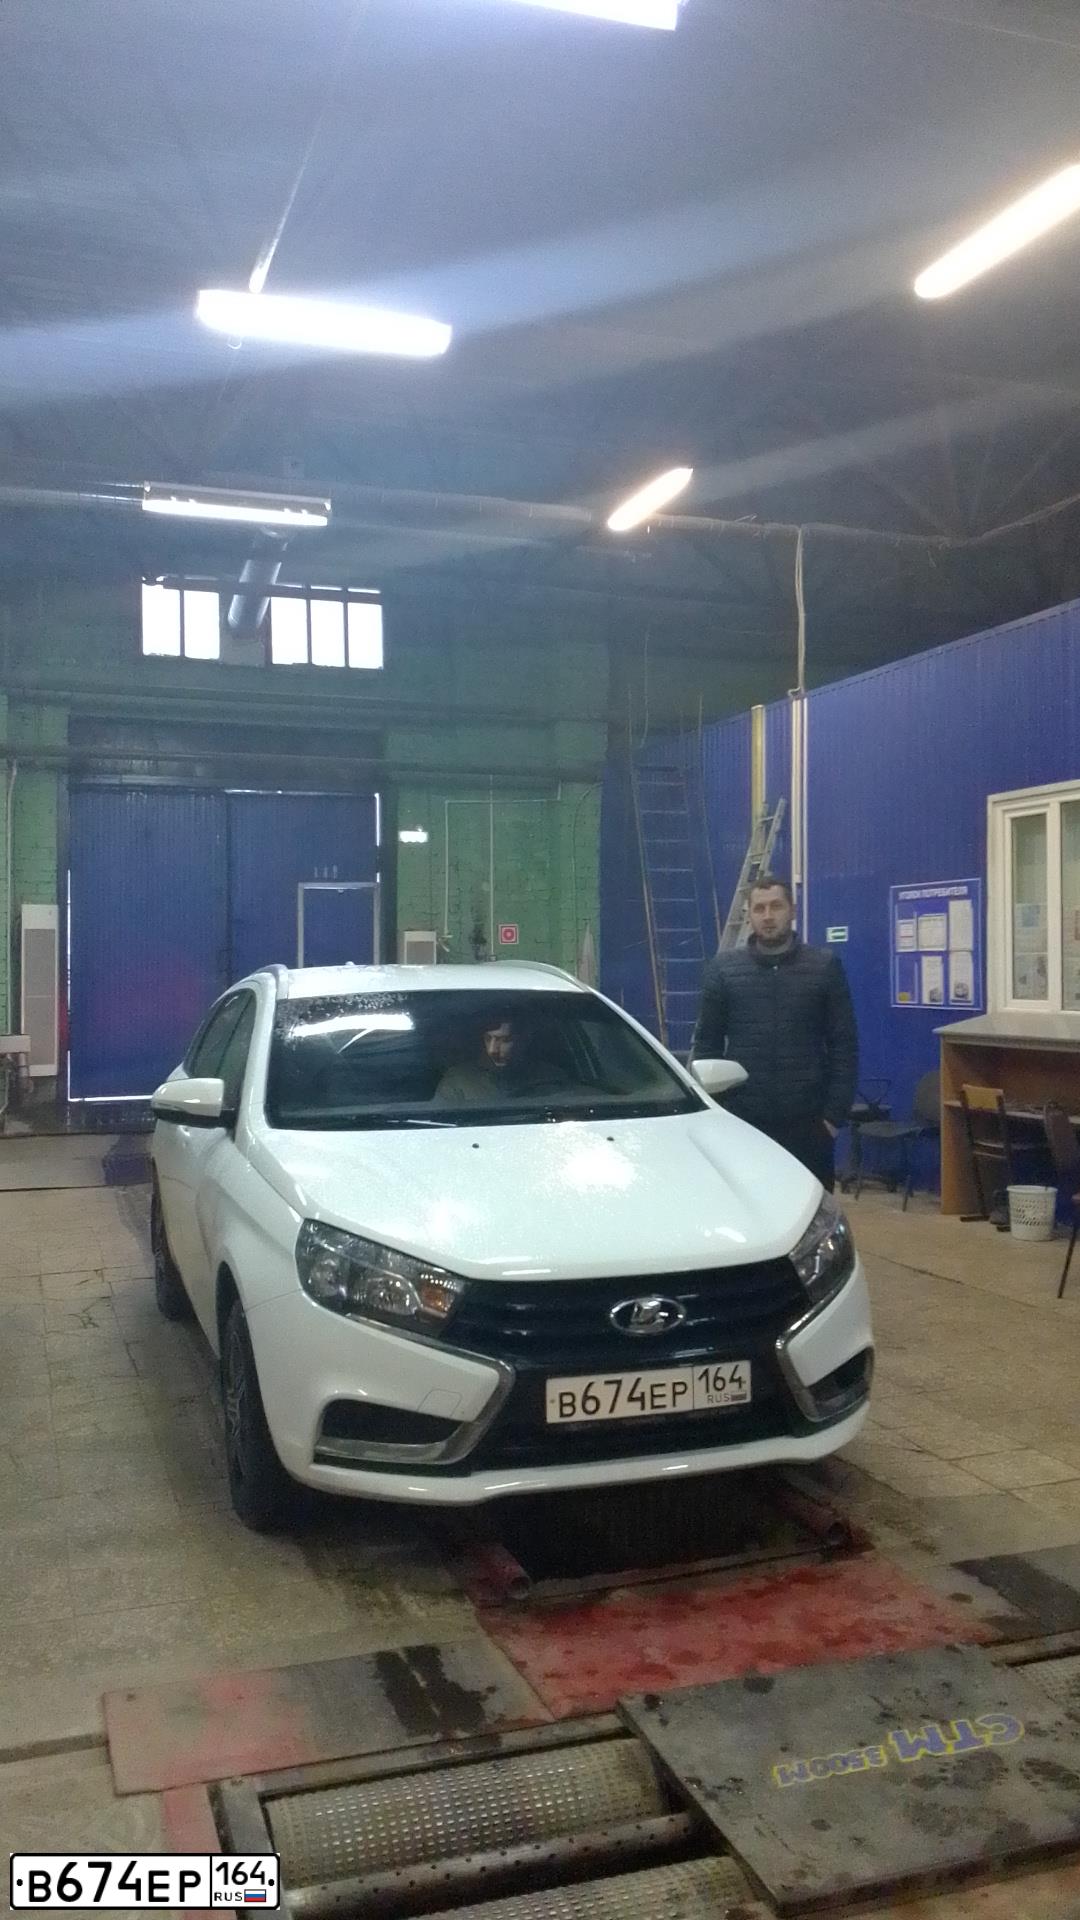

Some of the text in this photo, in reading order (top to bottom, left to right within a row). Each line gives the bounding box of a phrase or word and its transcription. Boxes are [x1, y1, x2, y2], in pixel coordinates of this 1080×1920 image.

[558, 1364, 743, 1418] В674ЕР 164
[707, 1393, 730, 1404] RUS
